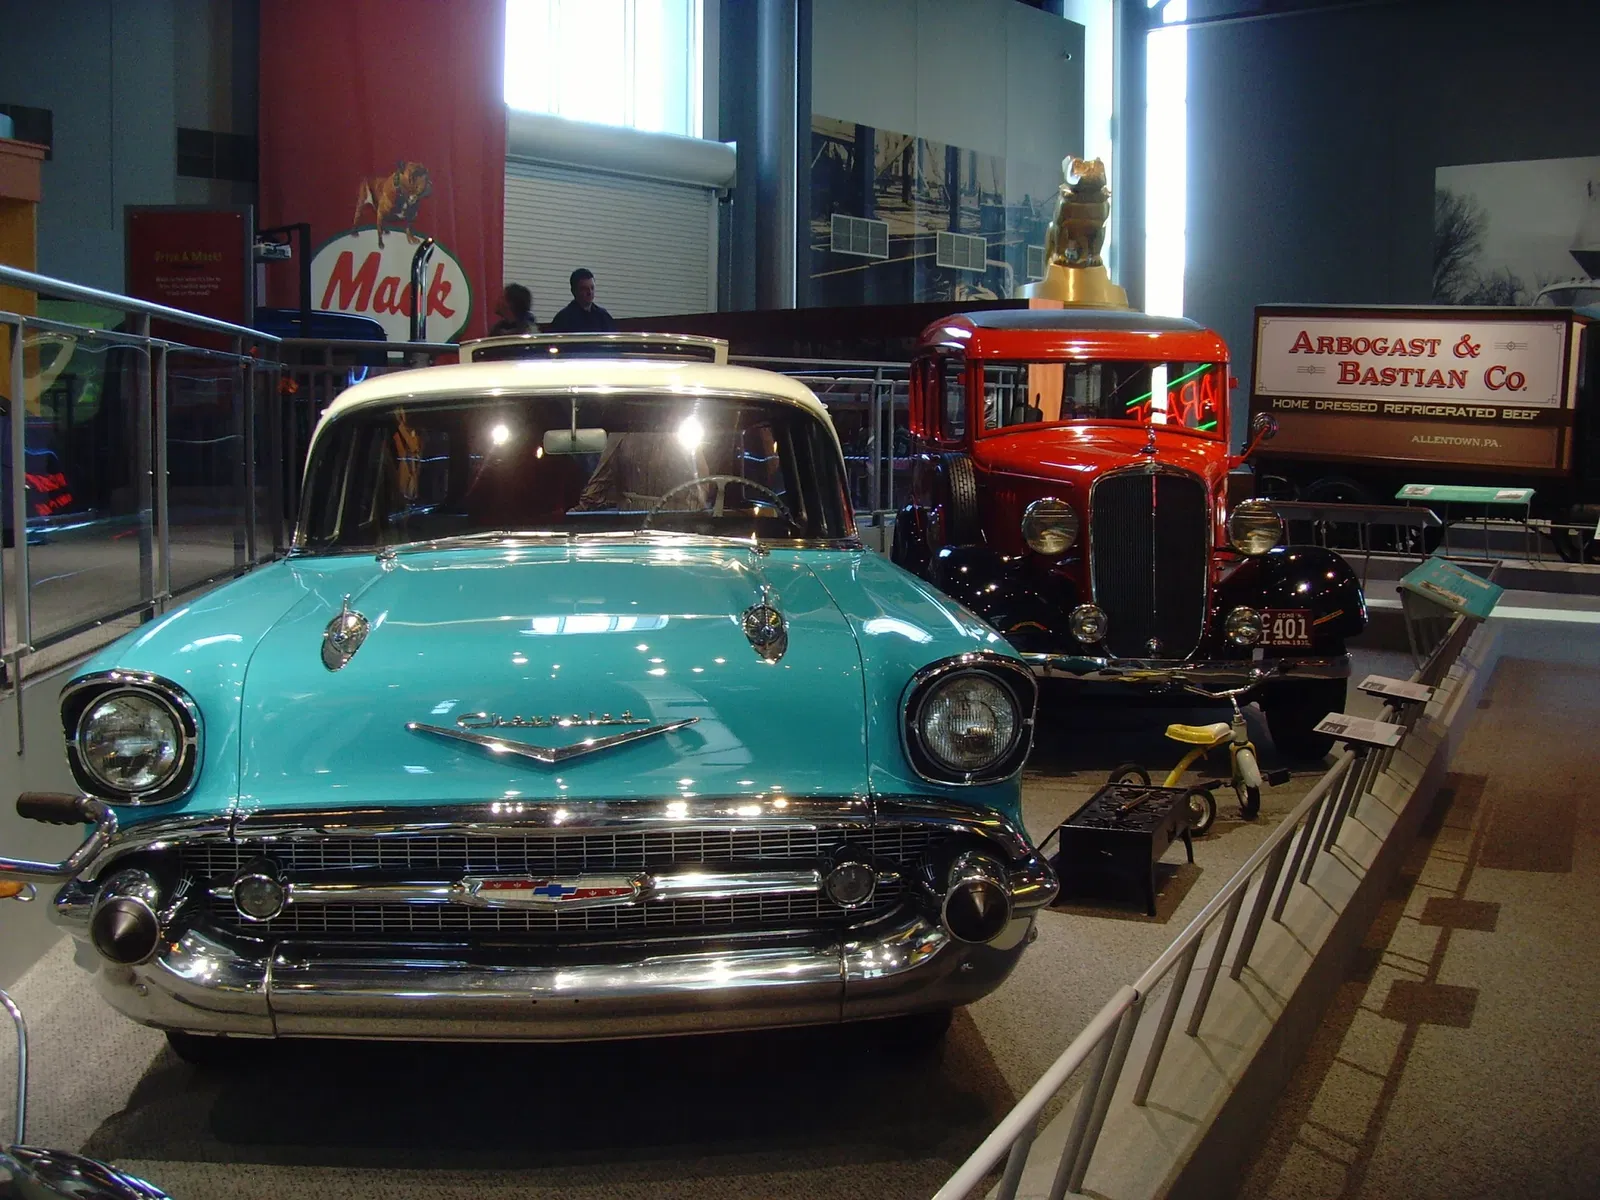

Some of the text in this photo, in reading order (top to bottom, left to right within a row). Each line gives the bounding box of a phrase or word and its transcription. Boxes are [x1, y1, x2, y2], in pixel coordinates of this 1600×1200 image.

[1288, 330, 1482, 358] ARBOGAST &
[1337, 361, 1469, 389] BASTIAN
[1272, 399, 1541, 420] HOME DRESSED REFRIGERATED BEEF
[1273, 618, 1308, 639] 401
